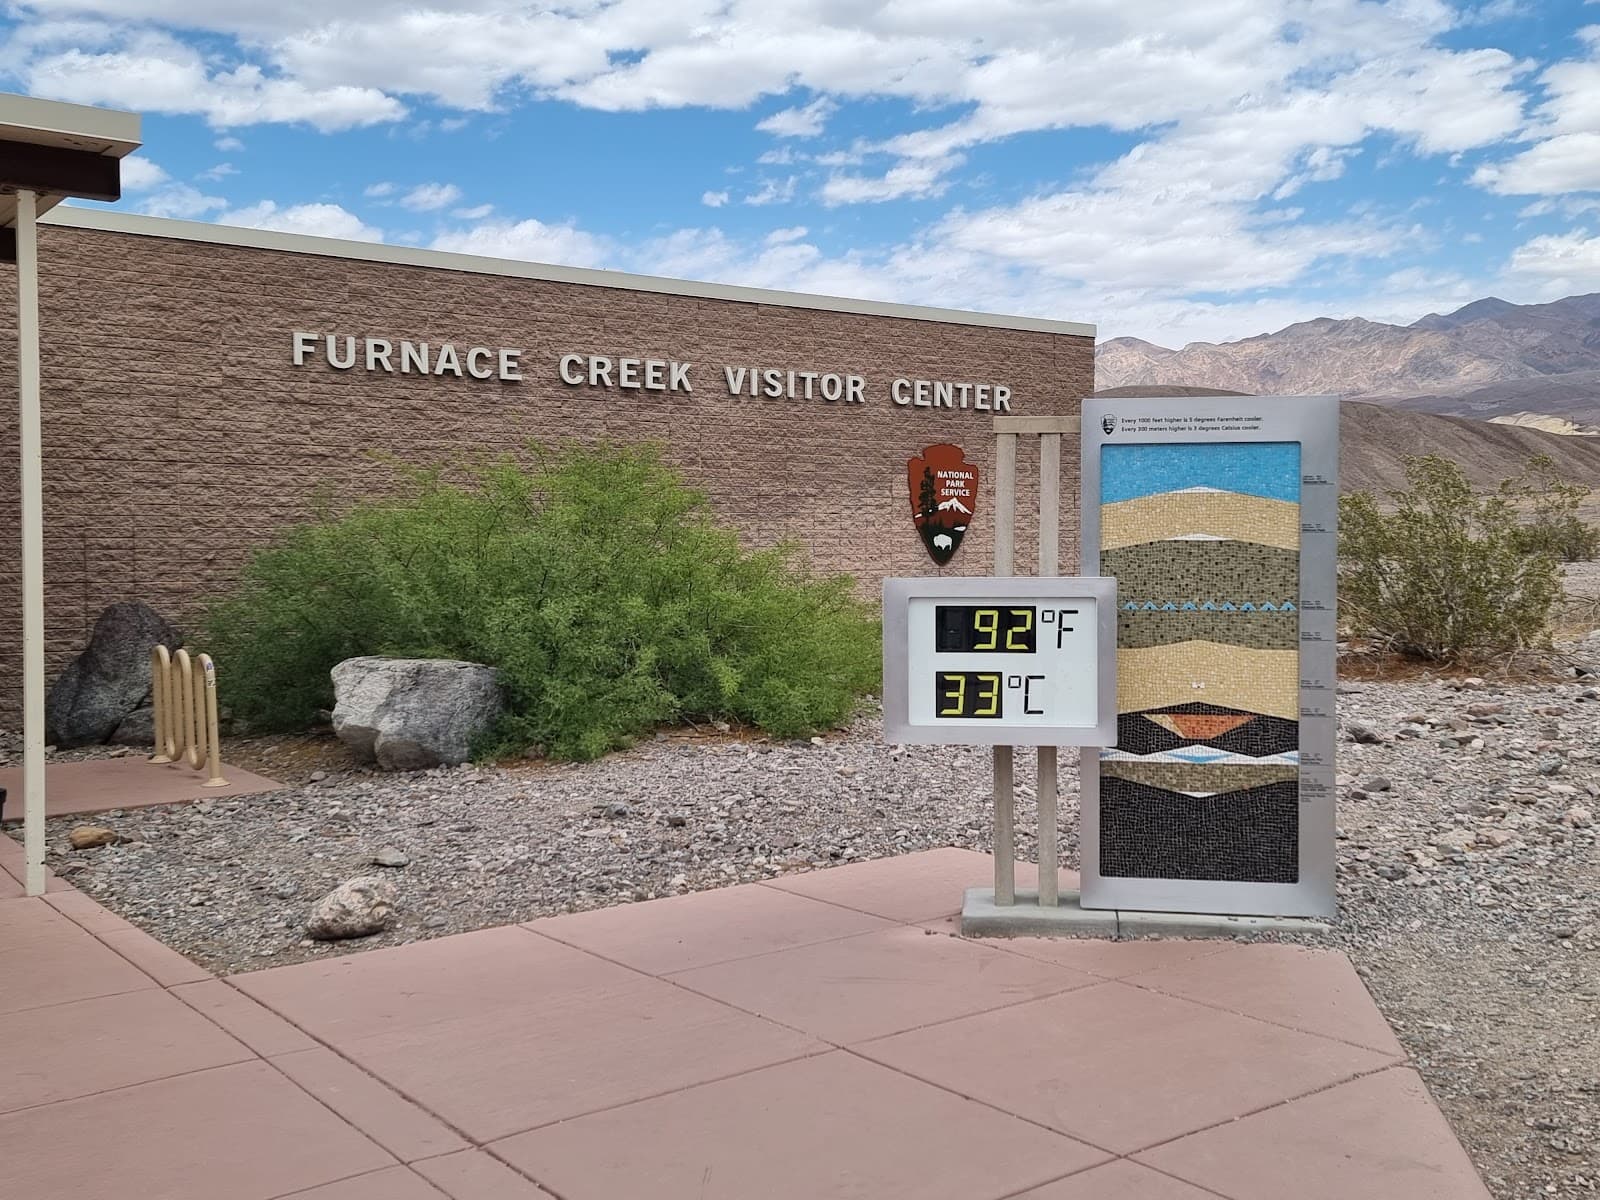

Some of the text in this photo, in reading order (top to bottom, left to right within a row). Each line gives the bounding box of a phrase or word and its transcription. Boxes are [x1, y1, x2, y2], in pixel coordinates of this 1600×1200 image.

[292, 331, 1012, 412] FURNACE CREEK VISITOR CENTER
[937, 470, 974, 480] NATIONAL
[945, 479, 965, 488] PARK
[940, 488, 970, 497] SERVICE
